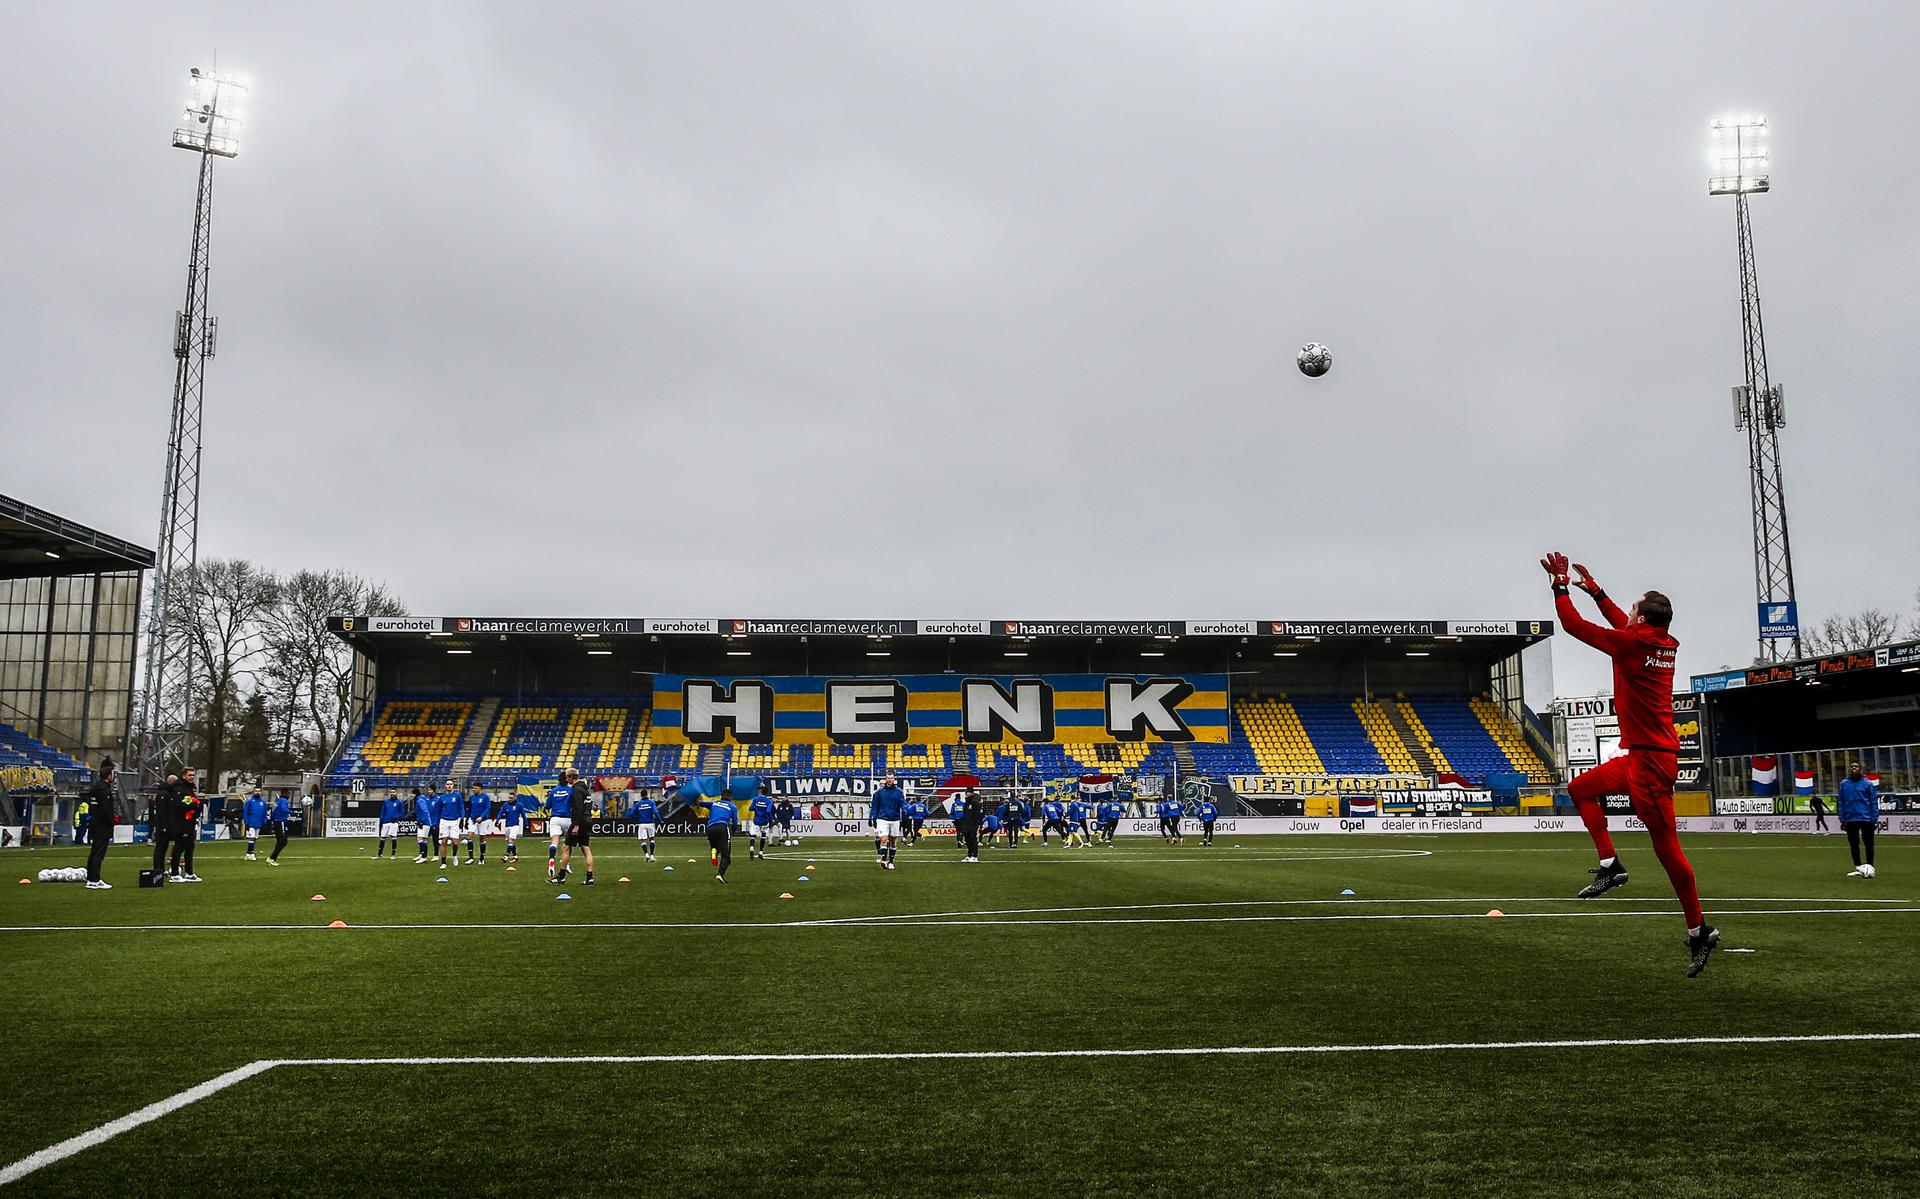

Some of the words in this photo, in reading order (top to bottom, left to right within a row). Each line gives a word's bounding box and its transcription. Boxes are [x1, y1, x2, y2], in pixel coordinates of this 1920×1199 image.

[376, 619, 435, 630] eurohotel
[471, 619, 630, 632] haanreclamewerk.nl
[652, 620, 711, 632] eurohotel
[746, 620, 903, 633] haanreclamewerk.nl
[925, 622, 983, 633] eurohotel
[1018, 622, 1172, 634] haanreclamewerk.nl
[1193, 622, 1250, 633] eurohotel
[1284, 622, 1434, 634] haanreclamewerk.nl
[1455, 622, 1510, 633] eurohotel
[682, 678, 1197, 744] HENK
[1567, 701, 1604, 716] LEVO
[1673, 700, 1694, 710] OLD
[1677, 770, 1699, 780] OLD
[353, 780, 364, 793] 10
[770, 777, 916, 795] LIWWADDN
[1382, 791, 1409, 803] STAY
[1411, 790, 1451, 803] STRONG
[1452, 790, 1492, 803] PATRICK
[1607, 800, 1630, 808] shop.nl
[1722, 801, 1739, 813] Auto
[1740, 800, 1773, 813] Buikema
[789, 824, 814, 833] ouw
[834, 821, 861, 835] Opel
[1132, 821, 1161, 832] deale
[1289, 820, 1320, 831] Jouw
[1340, 819, 1365, 832] Opel
[1382, 819, 1416, 830] dealer
[1419, 819, 1429, 830] in
[1431, 819, 1483, 830] Friesland
[1534, 818, 1564, 829] Jouw
[1733, 818, 1747, 832] Opel
[1754, 818, 1773, 830] dealer
[1781, 818, 1810, 830] Friesland
[1877, 817, 1889, 833] pel
[1899, 817, 1920, 831] deale
